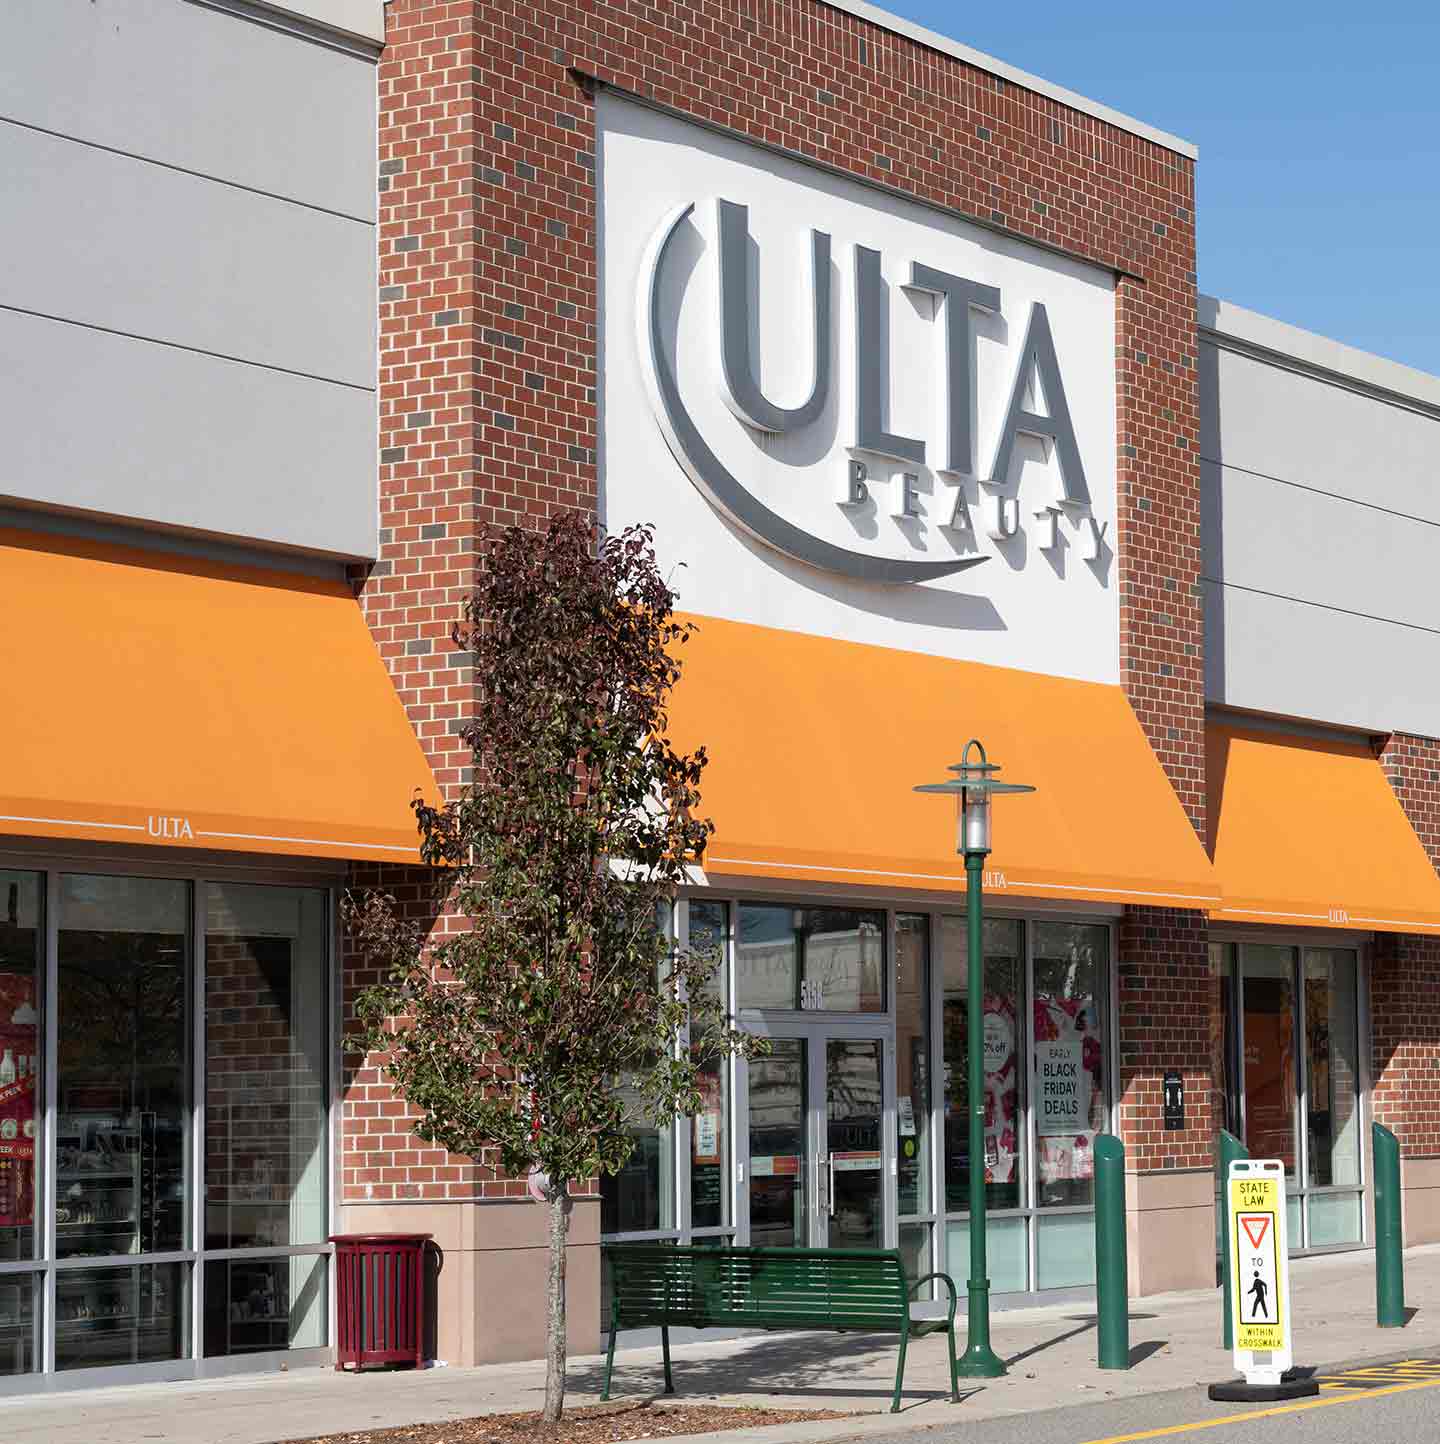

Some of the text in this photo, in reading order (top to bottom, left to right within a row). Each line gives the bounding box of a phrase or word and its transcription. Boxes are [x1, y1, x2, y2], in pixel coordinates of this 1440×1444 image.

[714, 196, 1093, 505] ULTA
[843, 459, 1109, 561] BEAUTY
[148, 816, 193, 839] ULTA
[1049, 1048, 1072, 1058] EARLY
[1043, 1063, 1077, 1077] BLACK
[1044, 1082, 1077, 1096] FRIDAY
[1044, 1100, 1079, 1115] DEALS
[1240, 1182, 1270, 1194] STATE
[1244, 1196, 1264, 1206] LAW
[1251, 1257, 1263, 1267] TO
[1247, 1327, 1274, 1336] WITHIN
[1239, 1338, 1282, 1348] CROSSWALK
